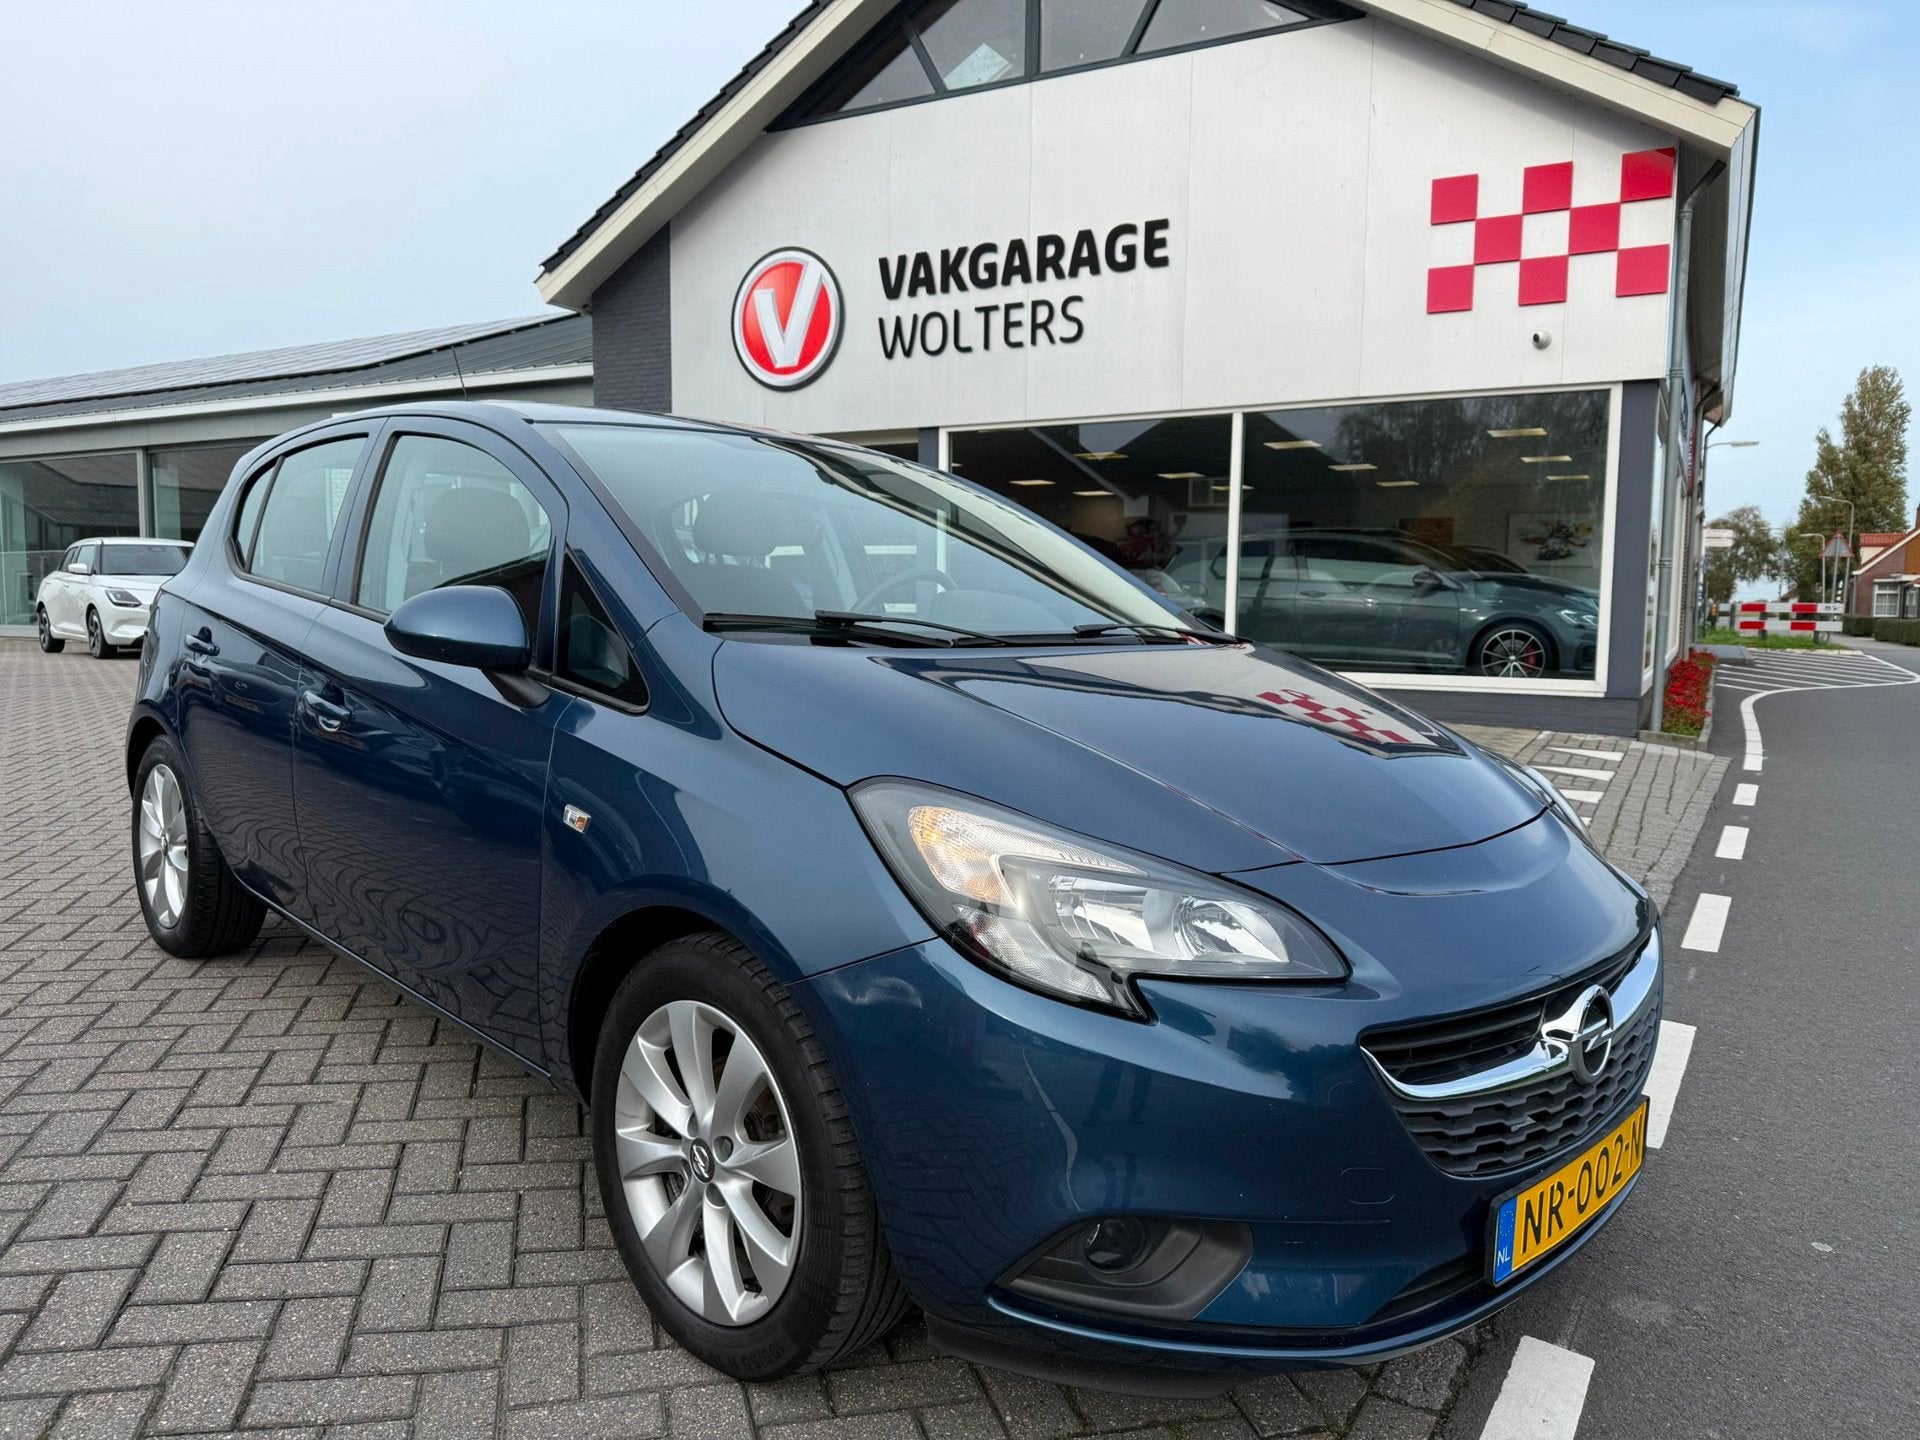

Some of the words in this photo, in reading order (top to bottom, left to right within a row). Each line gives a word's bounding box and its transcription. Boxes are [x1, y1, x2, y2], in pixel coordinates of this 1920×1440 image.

[878, 217, 1170, 301] VAKGARAGE
[753, 259, 826, 369] V
[878, 295, 1085, 360] WOLTERS
[1521, 1111, 1643, 1254] NR-002-N
[1497, 1246, 1511, 1267] NL
